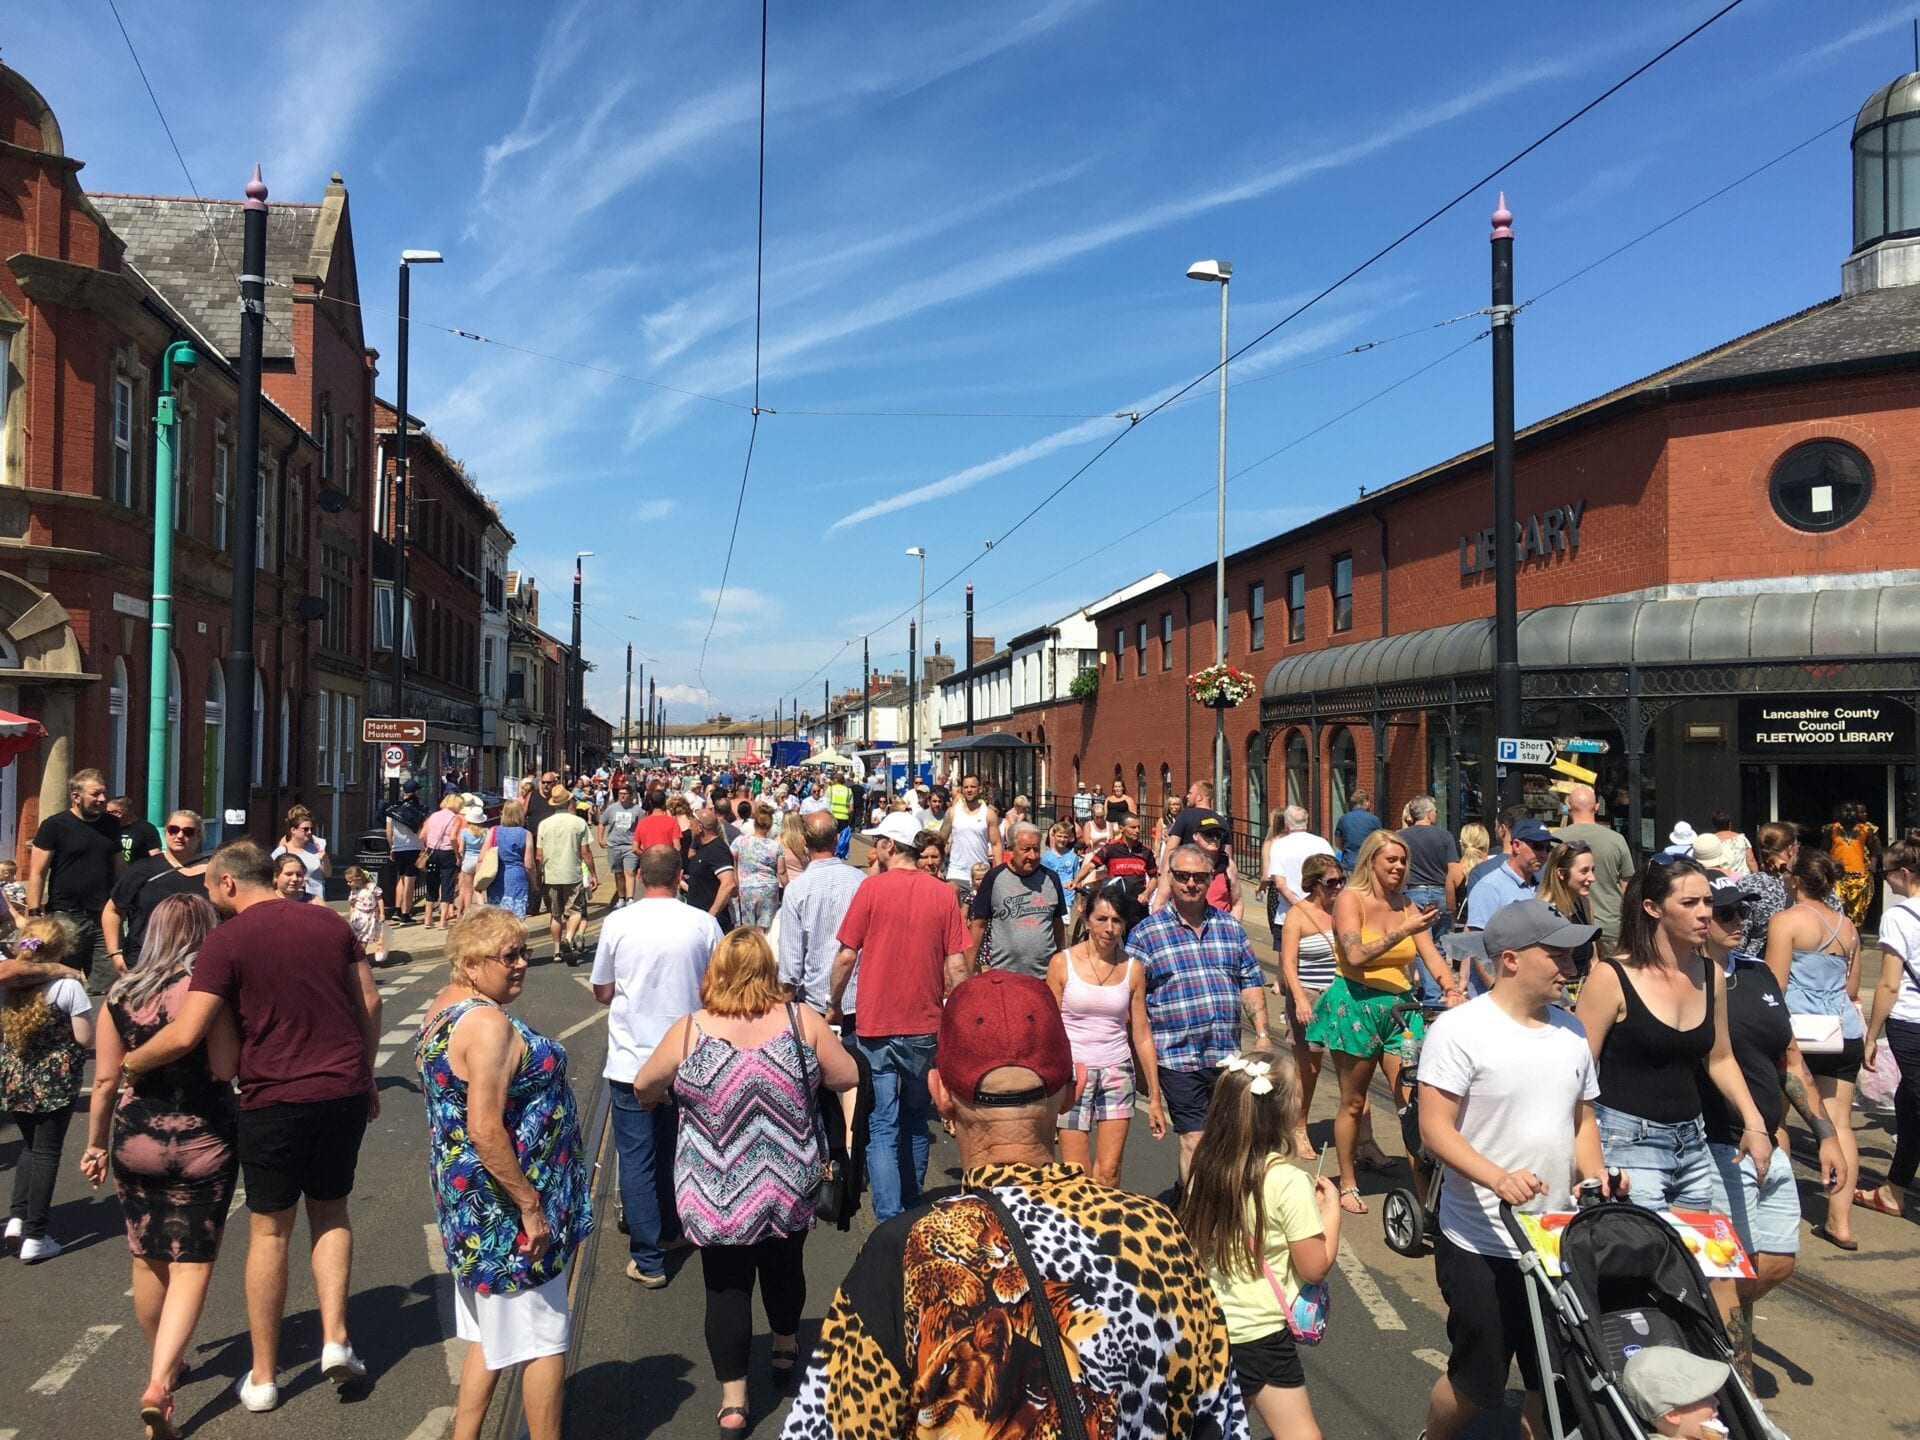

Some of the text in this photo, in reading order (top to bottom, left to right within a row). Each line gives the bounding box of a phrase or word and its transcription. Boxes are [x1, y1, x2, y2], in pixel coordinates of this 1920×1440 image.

[1763, 708, 1880, 719] Lancashire County
[368, 722, 397, 730] Market
[1799, 720, 1846, 731] Council
[1756, 731, 1895, 743] FLEETWOOD LIBRARY
[1503, 742, 1515, 758] P
[1519, 741, 1544, 750] Short
[387, 751, 402, 760] 20
[1522, 752, 1541, 762] stay
